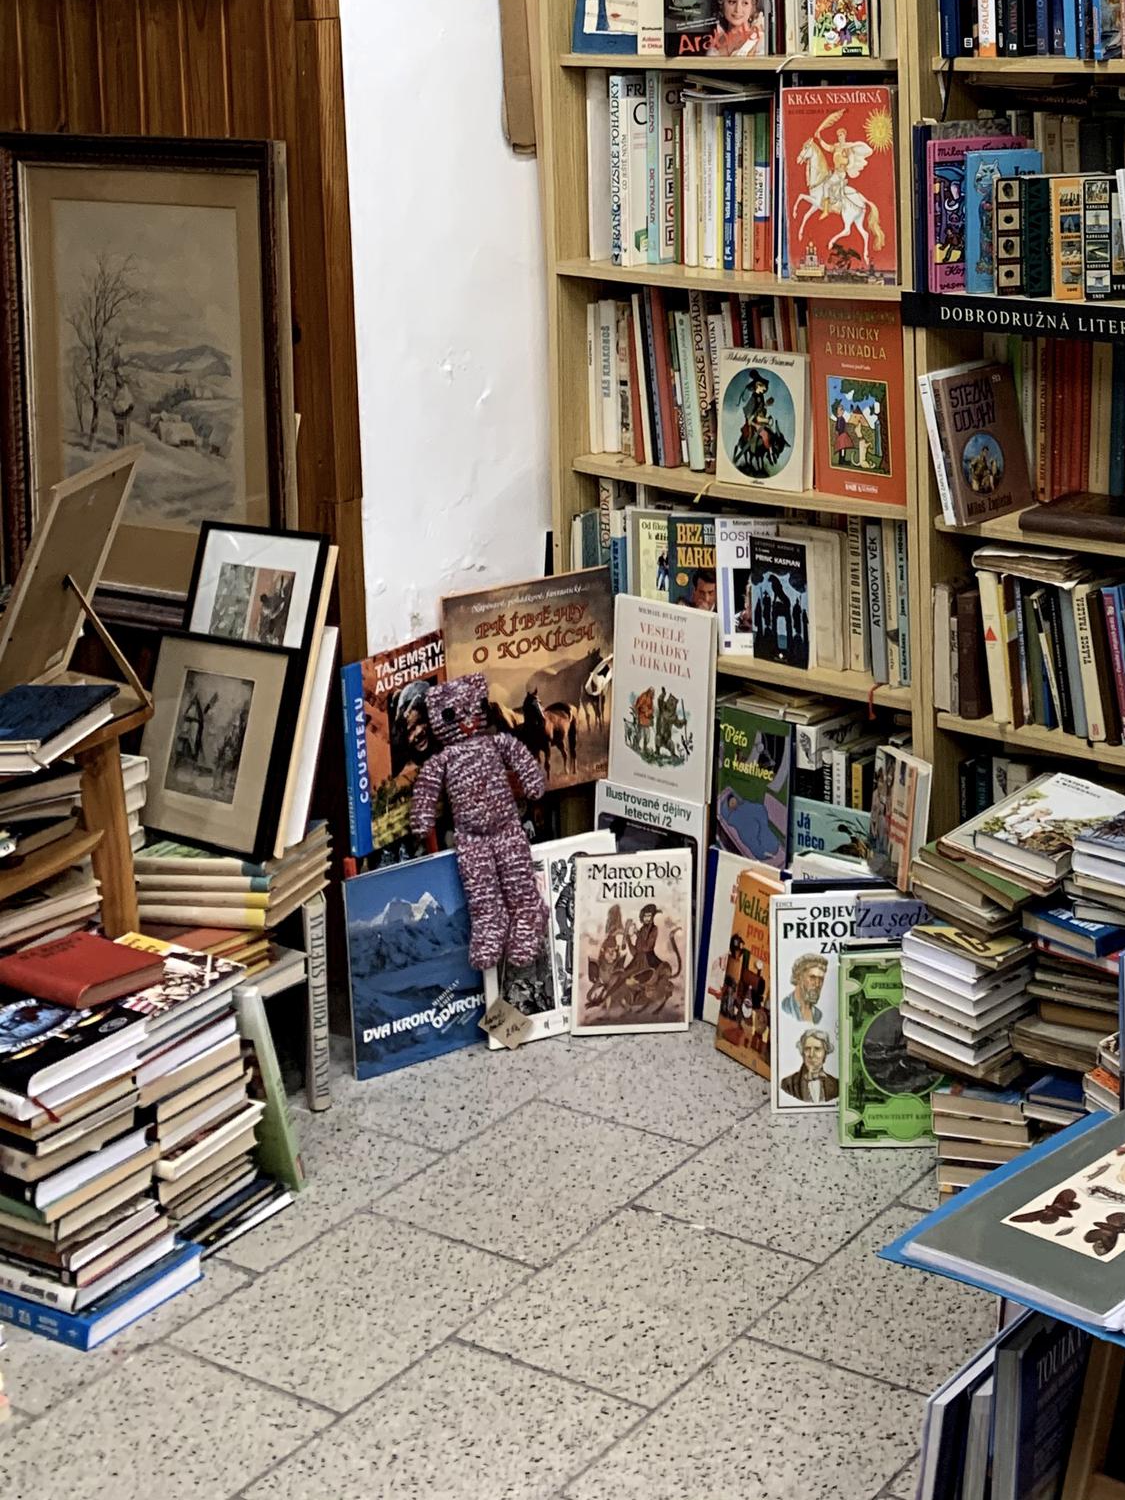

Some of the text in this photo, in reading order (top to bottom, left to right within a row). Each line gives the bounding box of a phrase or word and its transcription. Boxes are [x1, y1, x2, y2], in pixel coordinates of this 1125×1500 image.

[787, 89, 883, 106] KRÁSA NESMÍRNÁ
[610, 80, 620, 149] POHÁDKY
[940, 306, 1070, 330] DOBRODRUŽNÁ
[675, 523, 703, 544] BEZ
[869, 536, 882, 628] ATOMOVÝ VĚK
[474, 601, 589, 639] PŘÍBĚHY
[640, 620, 686, 644] VESELÉ
[472, 622, 596, 665] O KONÍCH
[633, 636, 689, 661] POHÁDKY
[375, 654, 446, 695] AUSTRÁLIE
[640, 653, 692, 680] ŘÍKADLA
[358, 696, 370, 803] COUSTEAU
[605, 785, 692, 822] Ilustrované dějiny
[624, 805, 661, 826] letectví
[797, 813, 811, 830] Já
[797, 829, 825, 851] něco
[602, 882, 656, 899] Milión
[857, 907, 885, 929] Za
[309, 913, 327, 978] SVĚTEM
[363, 1023, 392, 1044] DVA
[393, 1009, 437, 1031] KROKY
